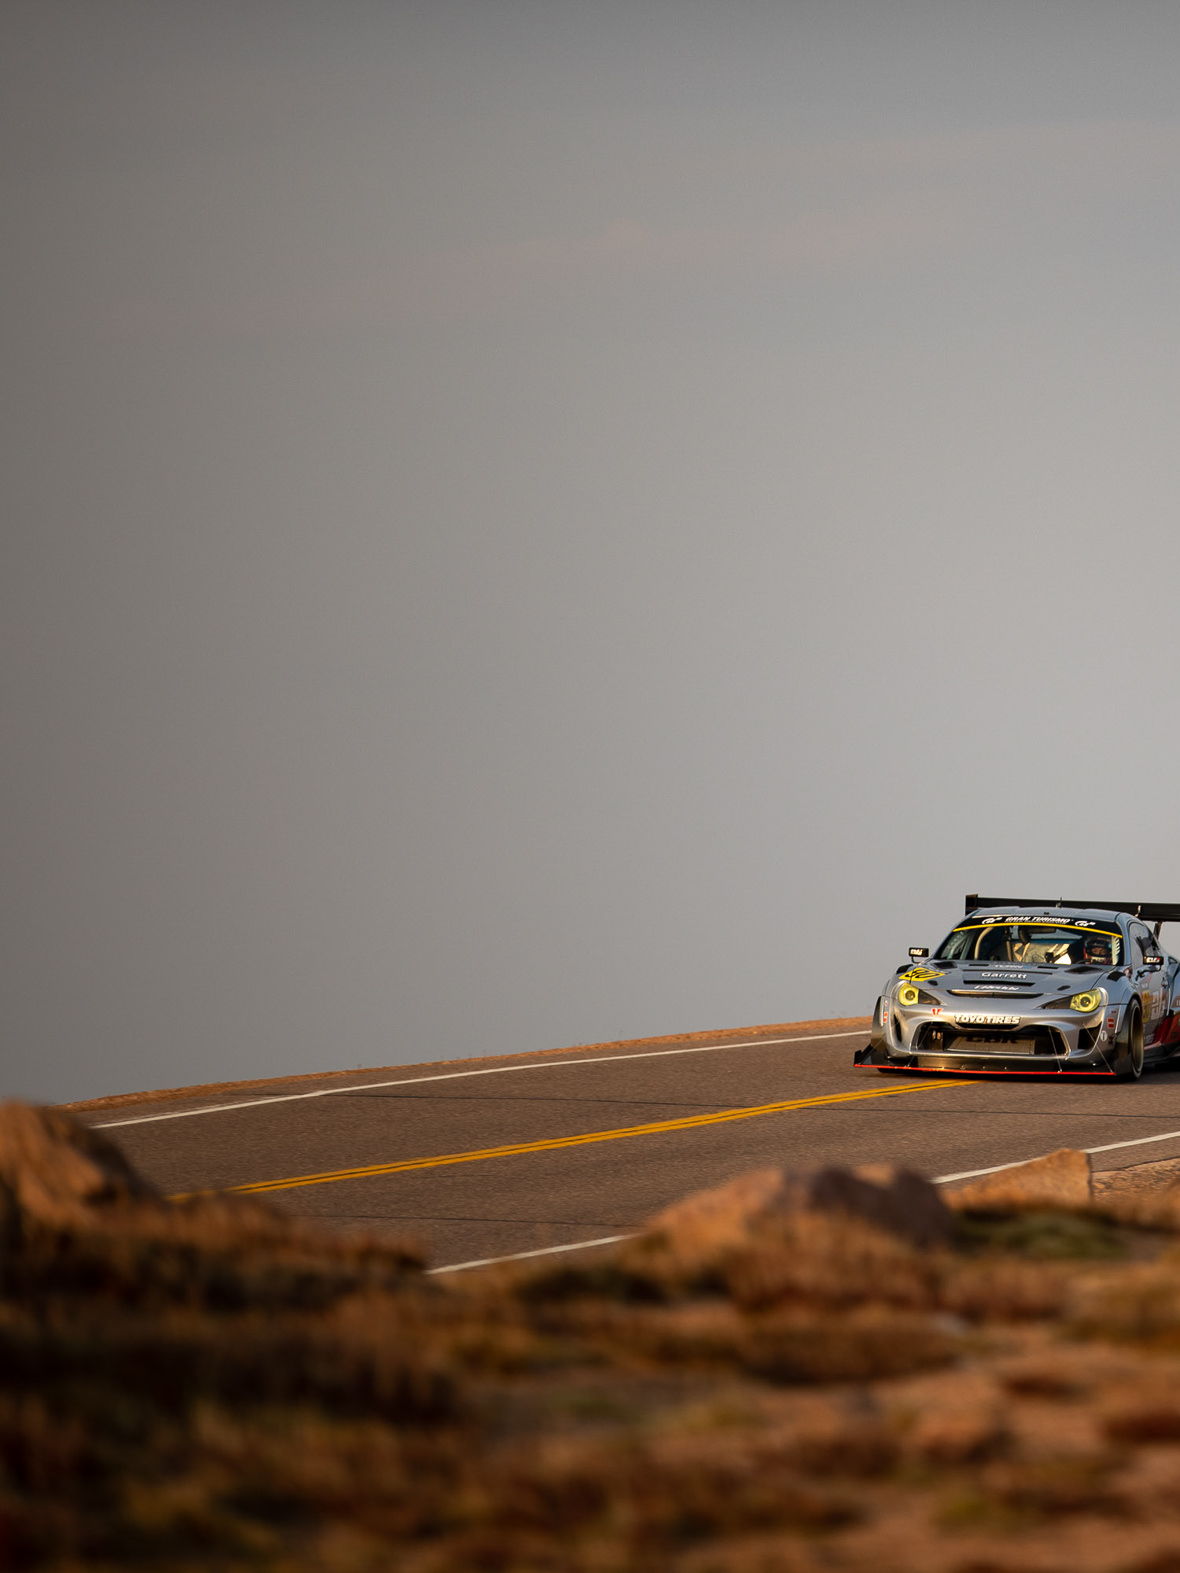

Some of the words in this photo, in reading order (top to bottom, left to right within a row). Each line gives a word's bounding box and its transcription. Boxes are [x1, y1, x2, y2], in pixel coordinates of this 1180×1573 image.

[1031, 916, 1071, 925] TURISMO
[981, 971, 1027, 979] Garrett
[954, 1014, 985, 1024] TOYO
[985, 1015, 1021, 1025] TIRES
